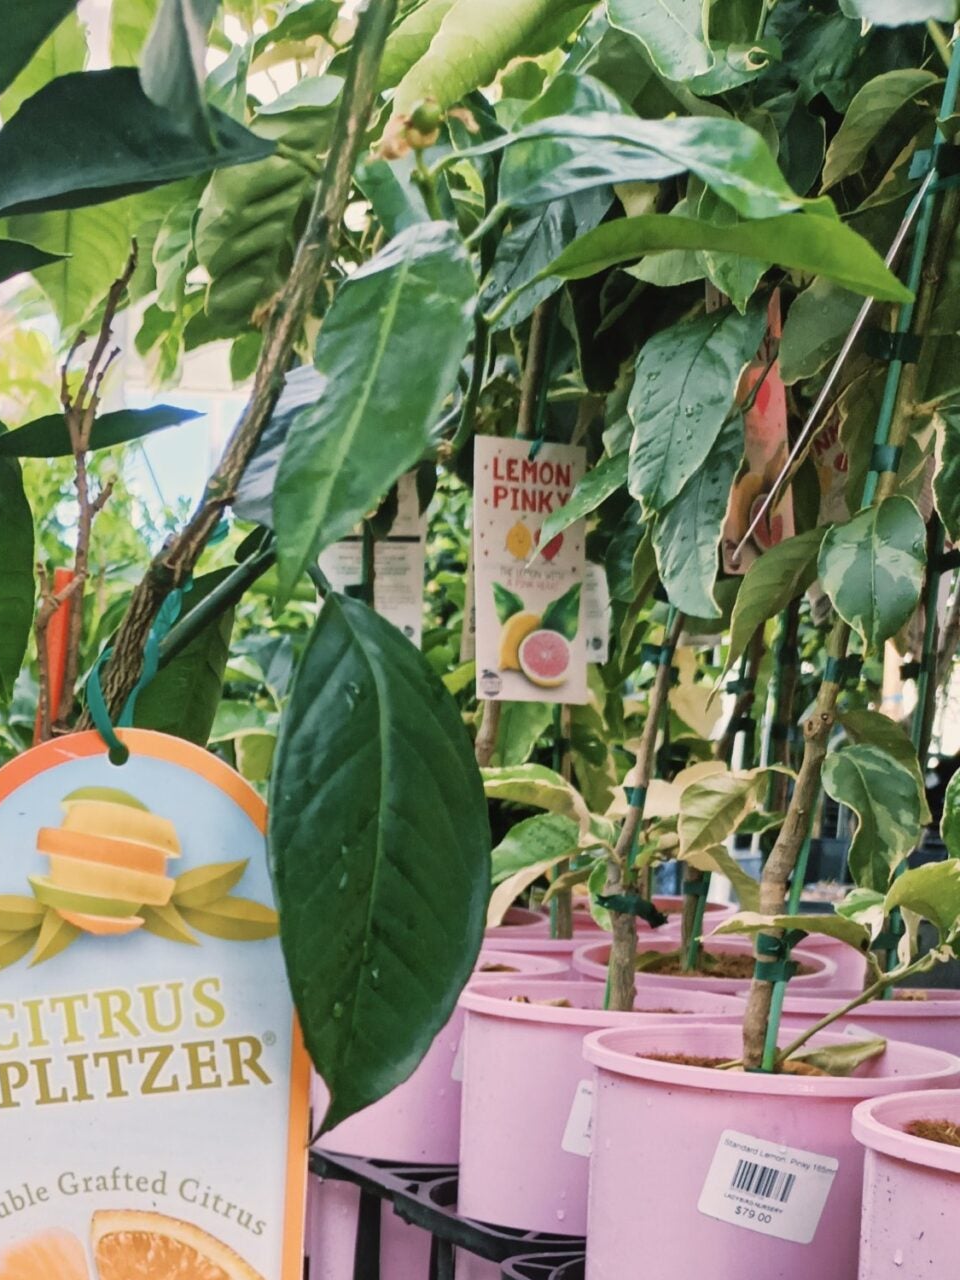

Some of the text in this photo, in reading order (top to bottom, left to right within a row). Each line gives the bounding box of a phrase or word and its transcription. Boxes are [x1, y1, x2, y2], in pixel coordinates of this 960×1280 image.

[493, 457, 570, 487] LEMON
[57, 1166, 168, 1196] Grafted
[178, 1177, 267, 1236] Citrus
